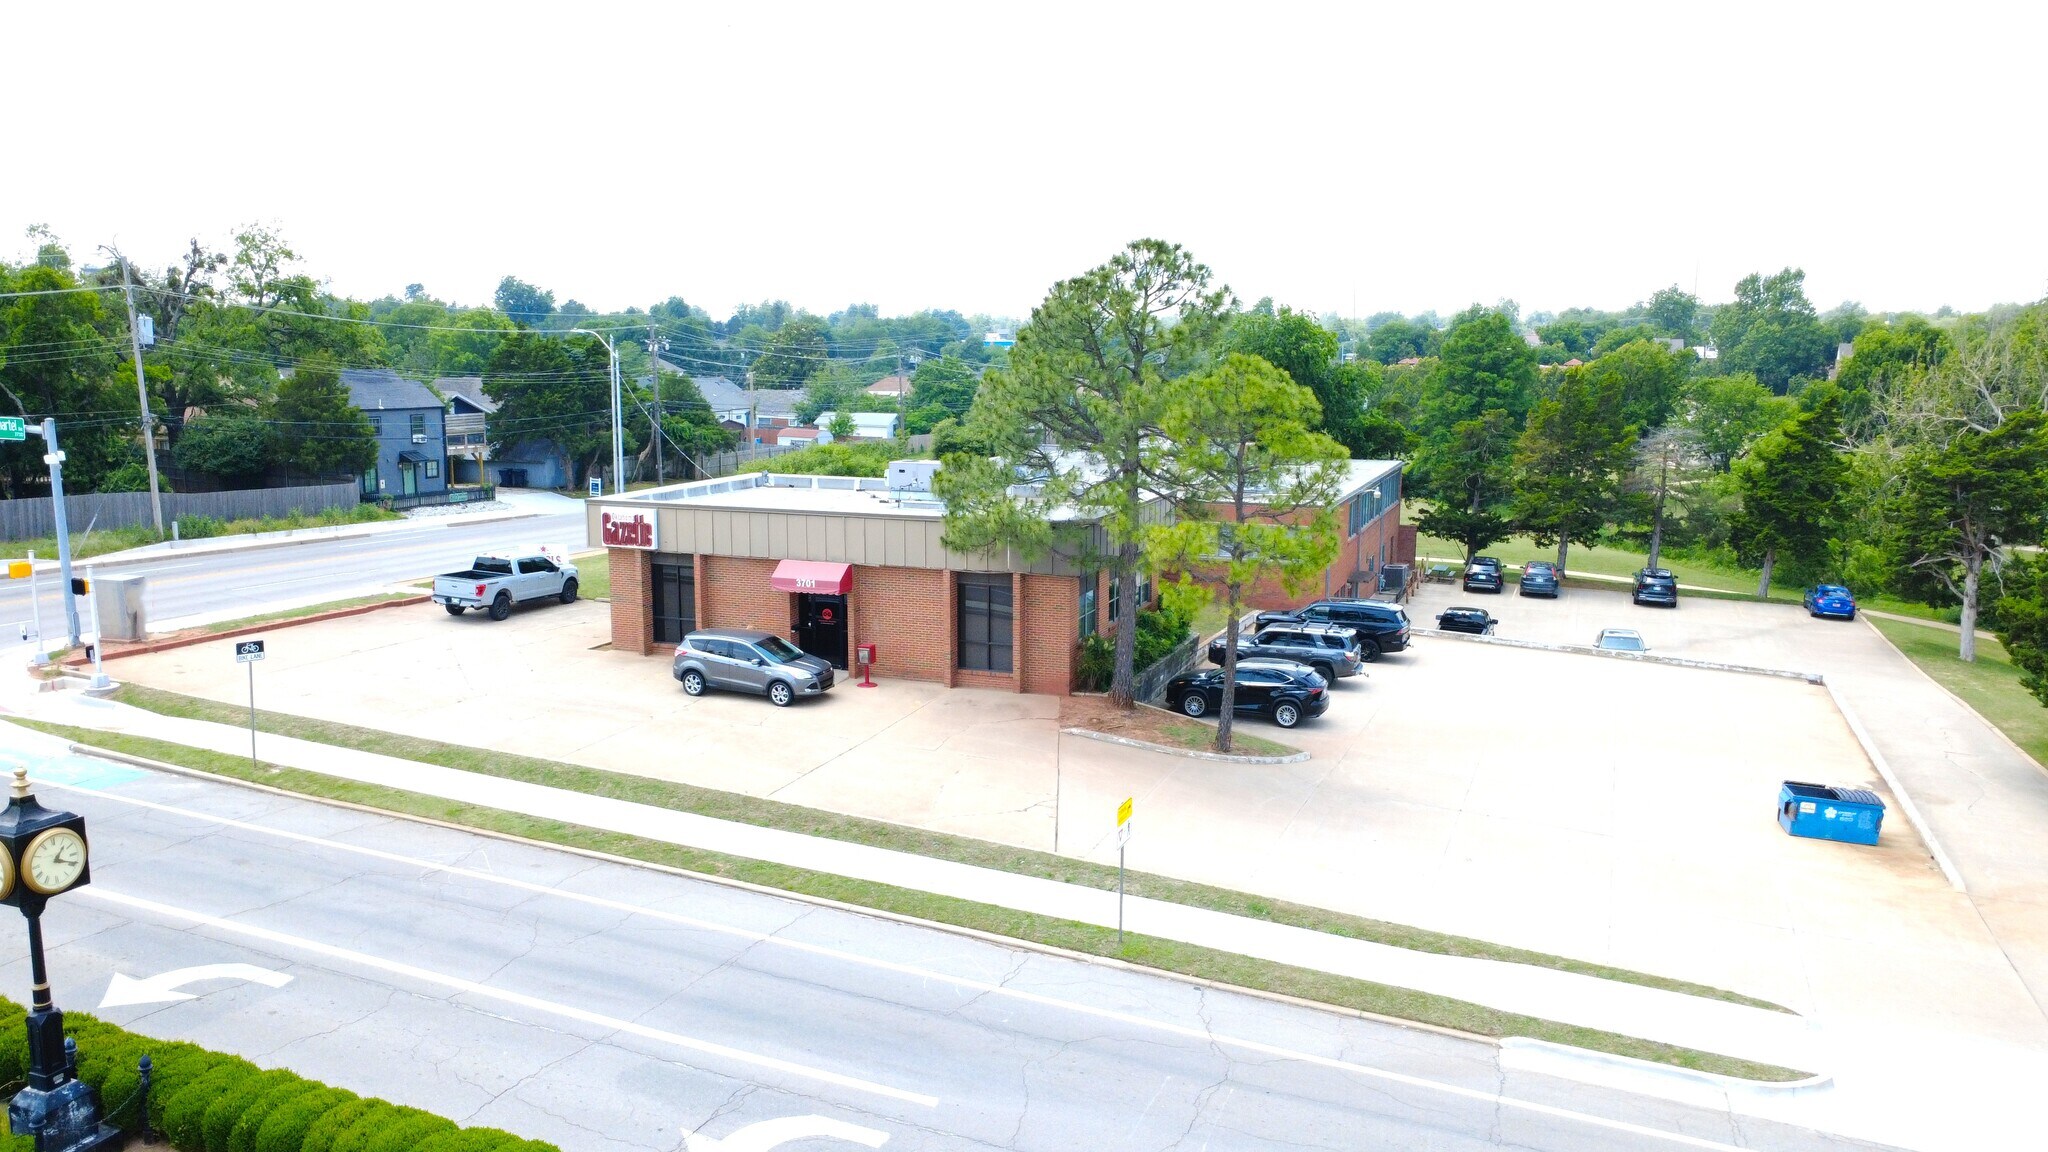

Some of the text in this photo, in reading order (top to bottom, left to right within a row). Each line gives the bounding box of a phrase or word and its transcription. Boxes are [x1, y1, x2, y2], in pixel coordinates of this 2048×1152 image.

[0, 419, 16, 431] artel
[602, 512, 652, 547] Gazette
[796, 578, 816, 588] 3701
